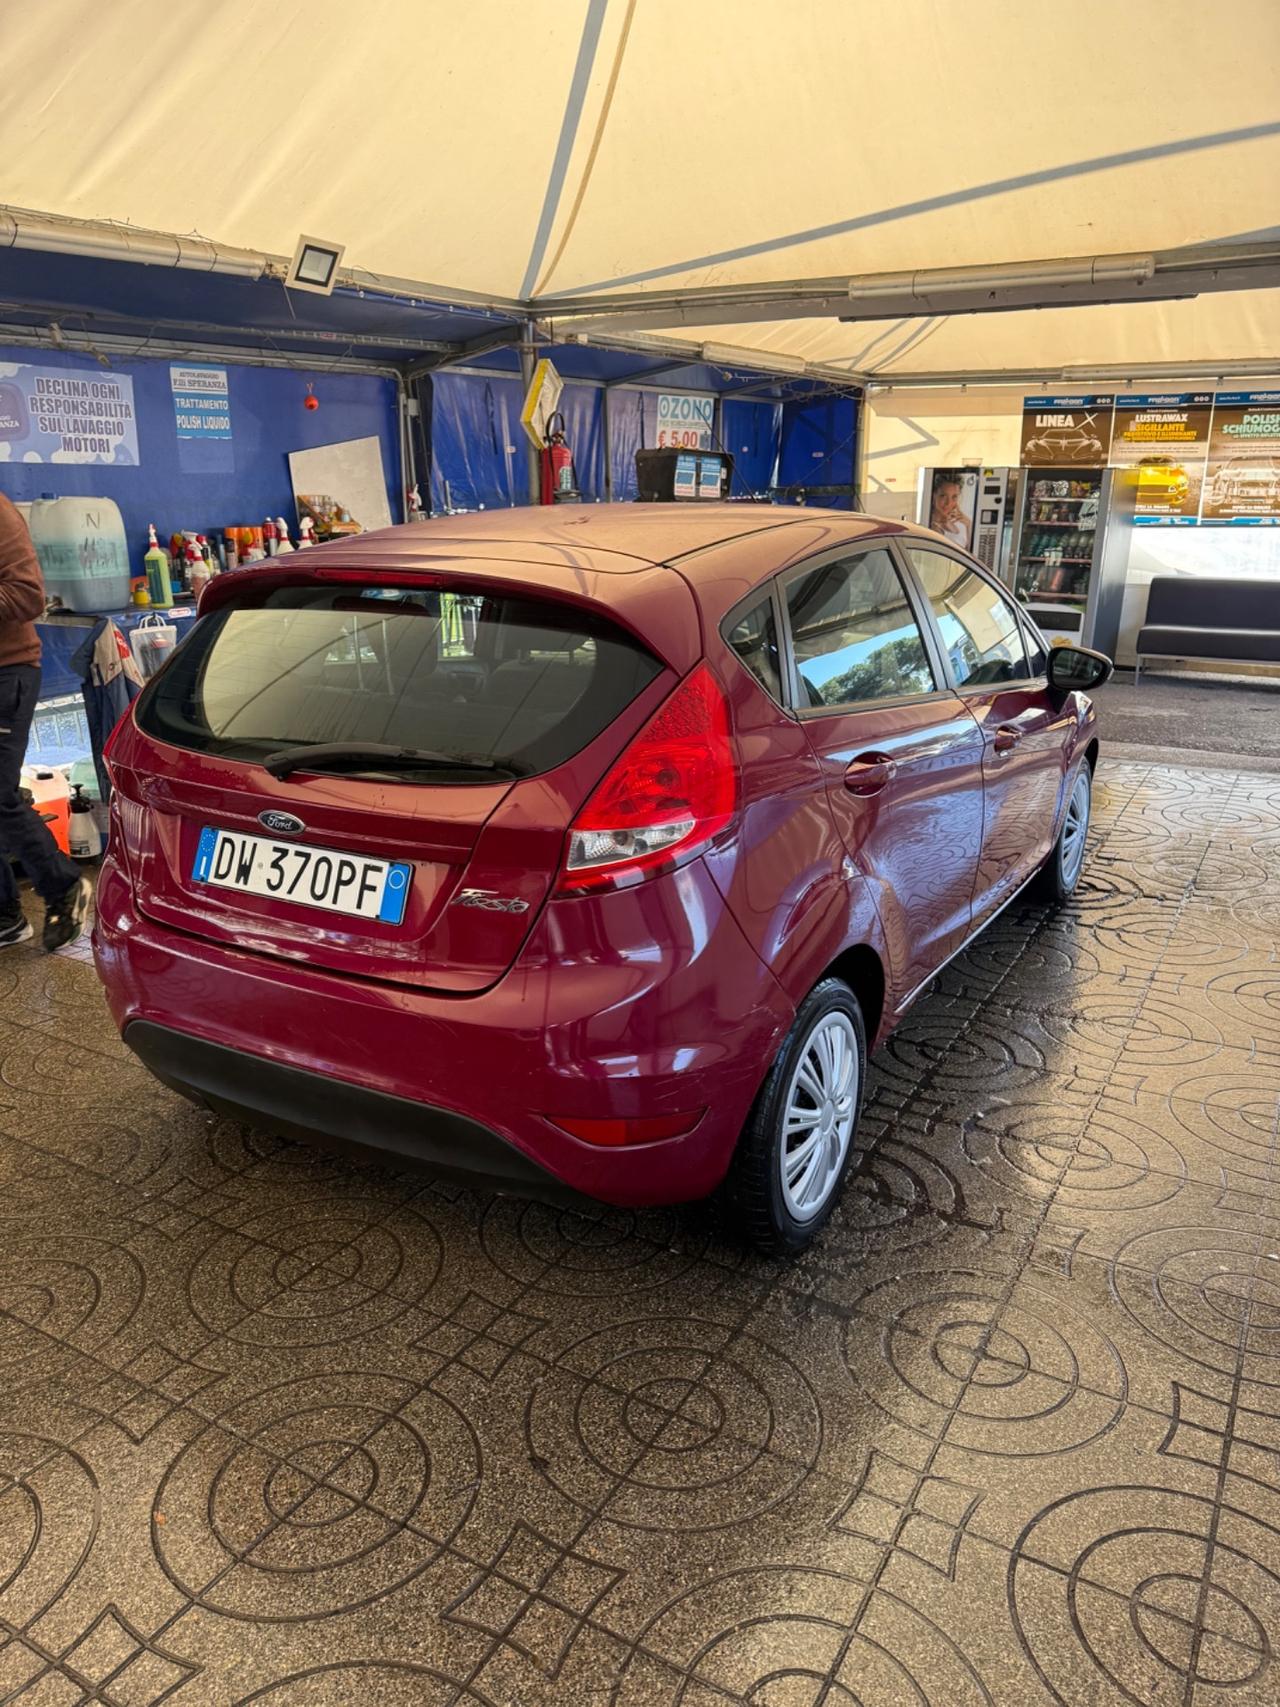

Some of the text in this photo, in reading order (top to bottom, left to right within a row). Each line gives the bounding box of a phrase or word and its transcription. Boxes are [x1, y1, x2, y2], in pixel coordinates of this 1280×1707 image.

[35, 378, 120, 401] DECLINA OGNI
[187, 379, 227, 389] SPERANZA
[29, 396, 132, 419] RESPONSABILITÀ
[175, 397, 229, 411] TRATTAMENTO
[659, 396, 712, 421] OZONO
[39, 416, 125, 437] SUL LAVAGGIO
[176, 414, 231, 431] POLISH LIQUIDO
[1035, 410, 1098, 431] LINEA X
[1134, 413, 1189, 423] LUSTRAWAX
[1135, 423, 1186, 432] SIGILLANTE
[61, 436, 111, 454] MOTORI
[267, 814, 292, 830] Ford
[213, 837, 383, 910] DW 370PF
